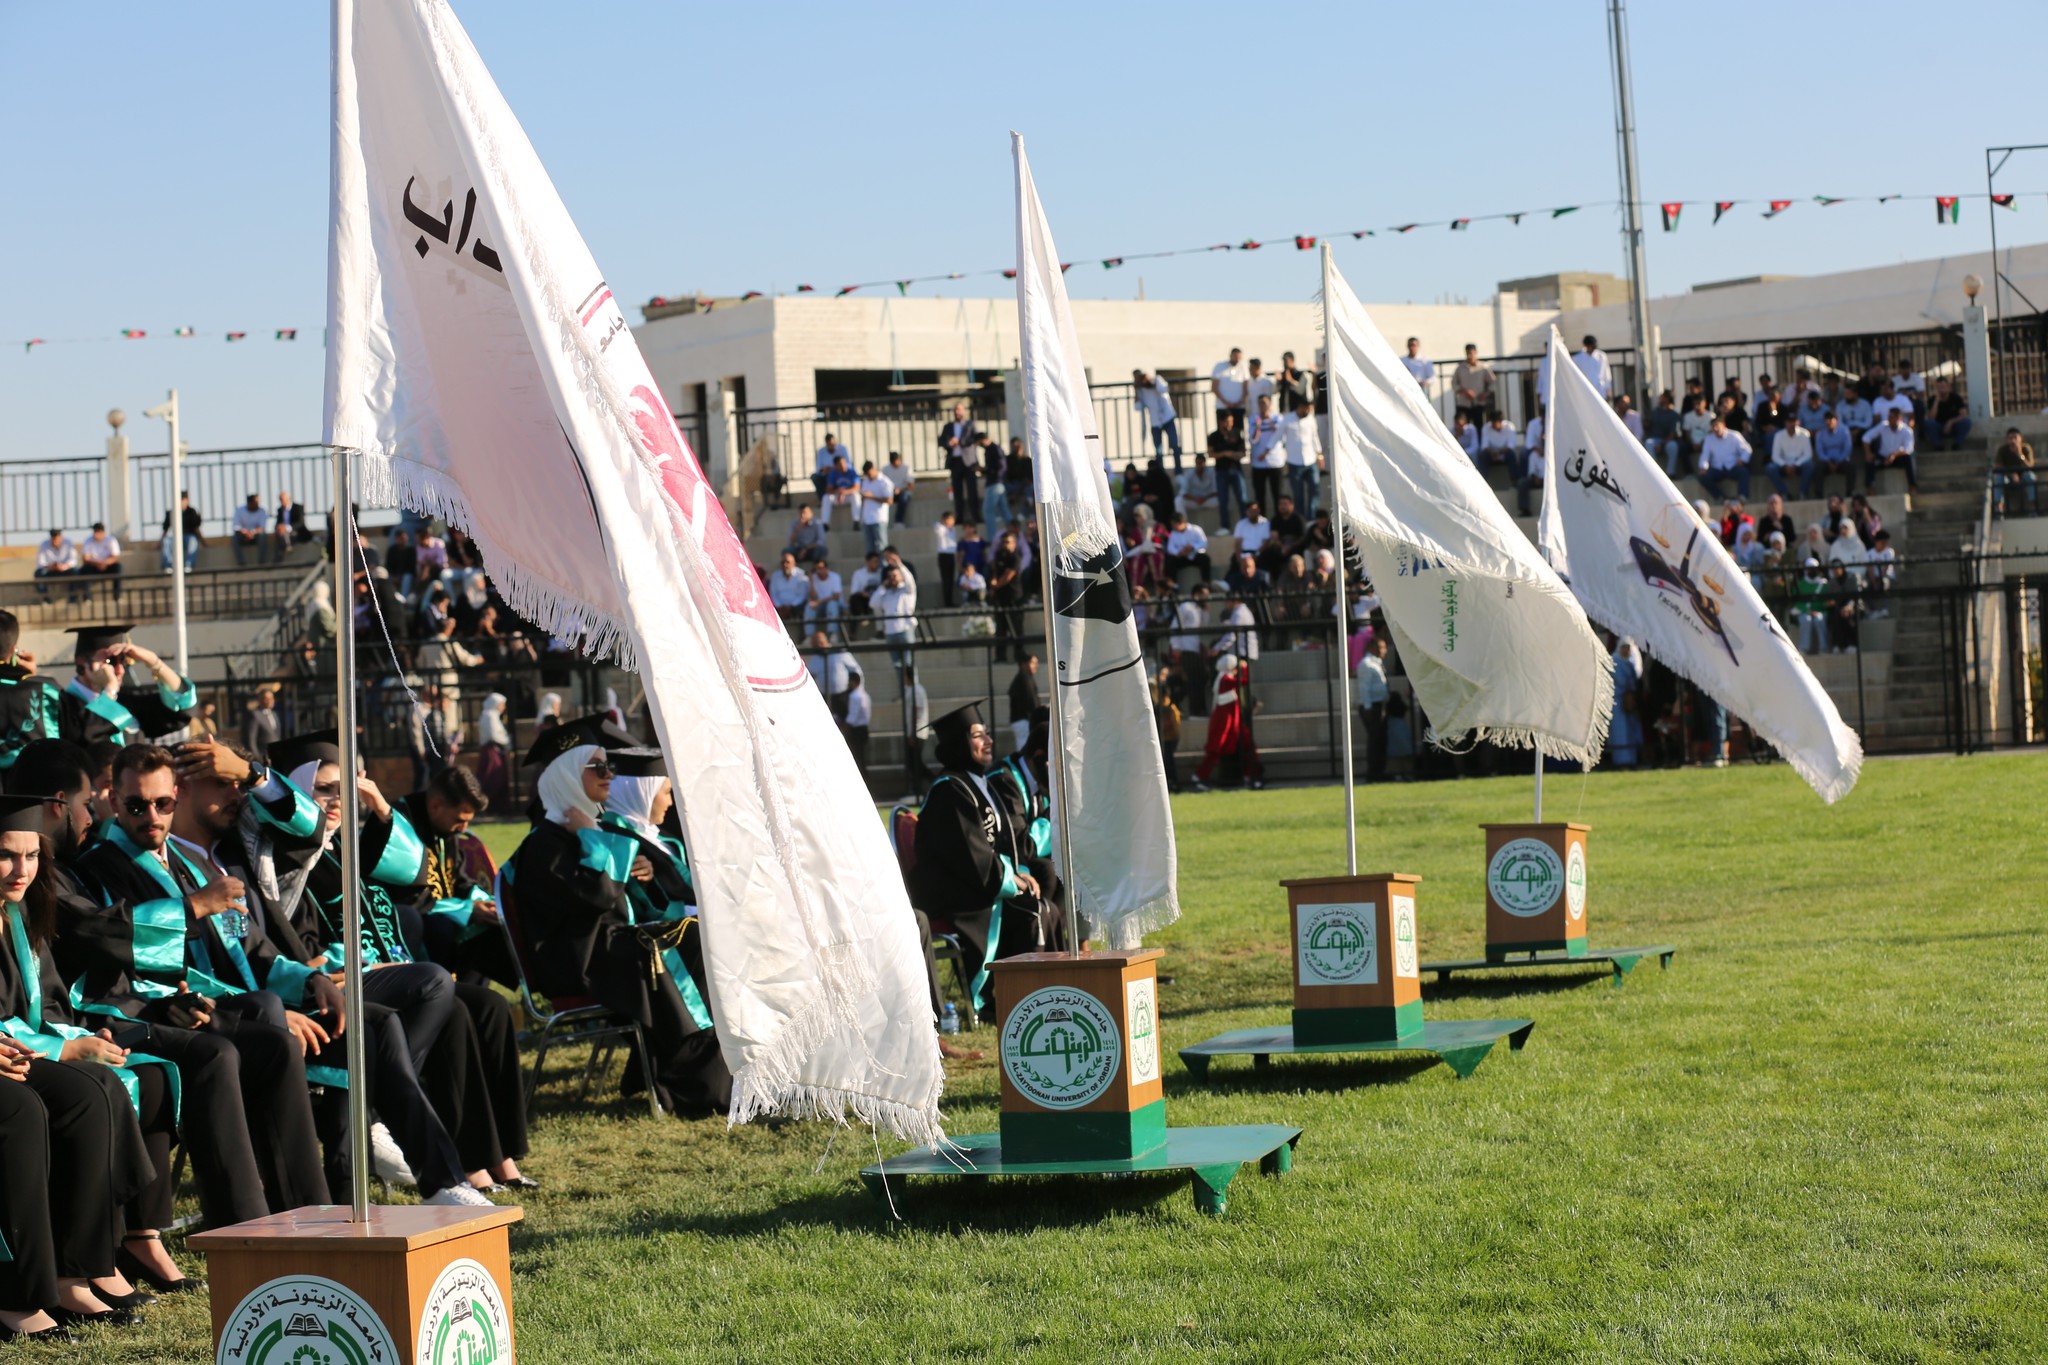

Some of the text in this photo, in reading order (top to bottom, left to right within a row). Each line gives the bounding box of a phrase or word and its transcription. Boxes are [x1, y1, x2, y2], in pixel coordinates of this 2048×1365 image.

[1035, 993, 1084, 1007] الزيتونة
[1084, 1001, 1107, 1034] جامعة
[1012, 1061, 1051, 1101] AL-ZAYTOONAH
[1051, 1087, 1090, 1102] UNIVERSITY
[1090, 1084, 1099, 1092] OF
[1099, 1055, 1112, 1085] JORDAN
[267, 1288, 347, 1314] الزيتونة
[440, 1272, 480, 1300] الزيتونة
[480, 1279, 500, 1328] جامعة
[346, 1305, 382, 1363] جامعة
